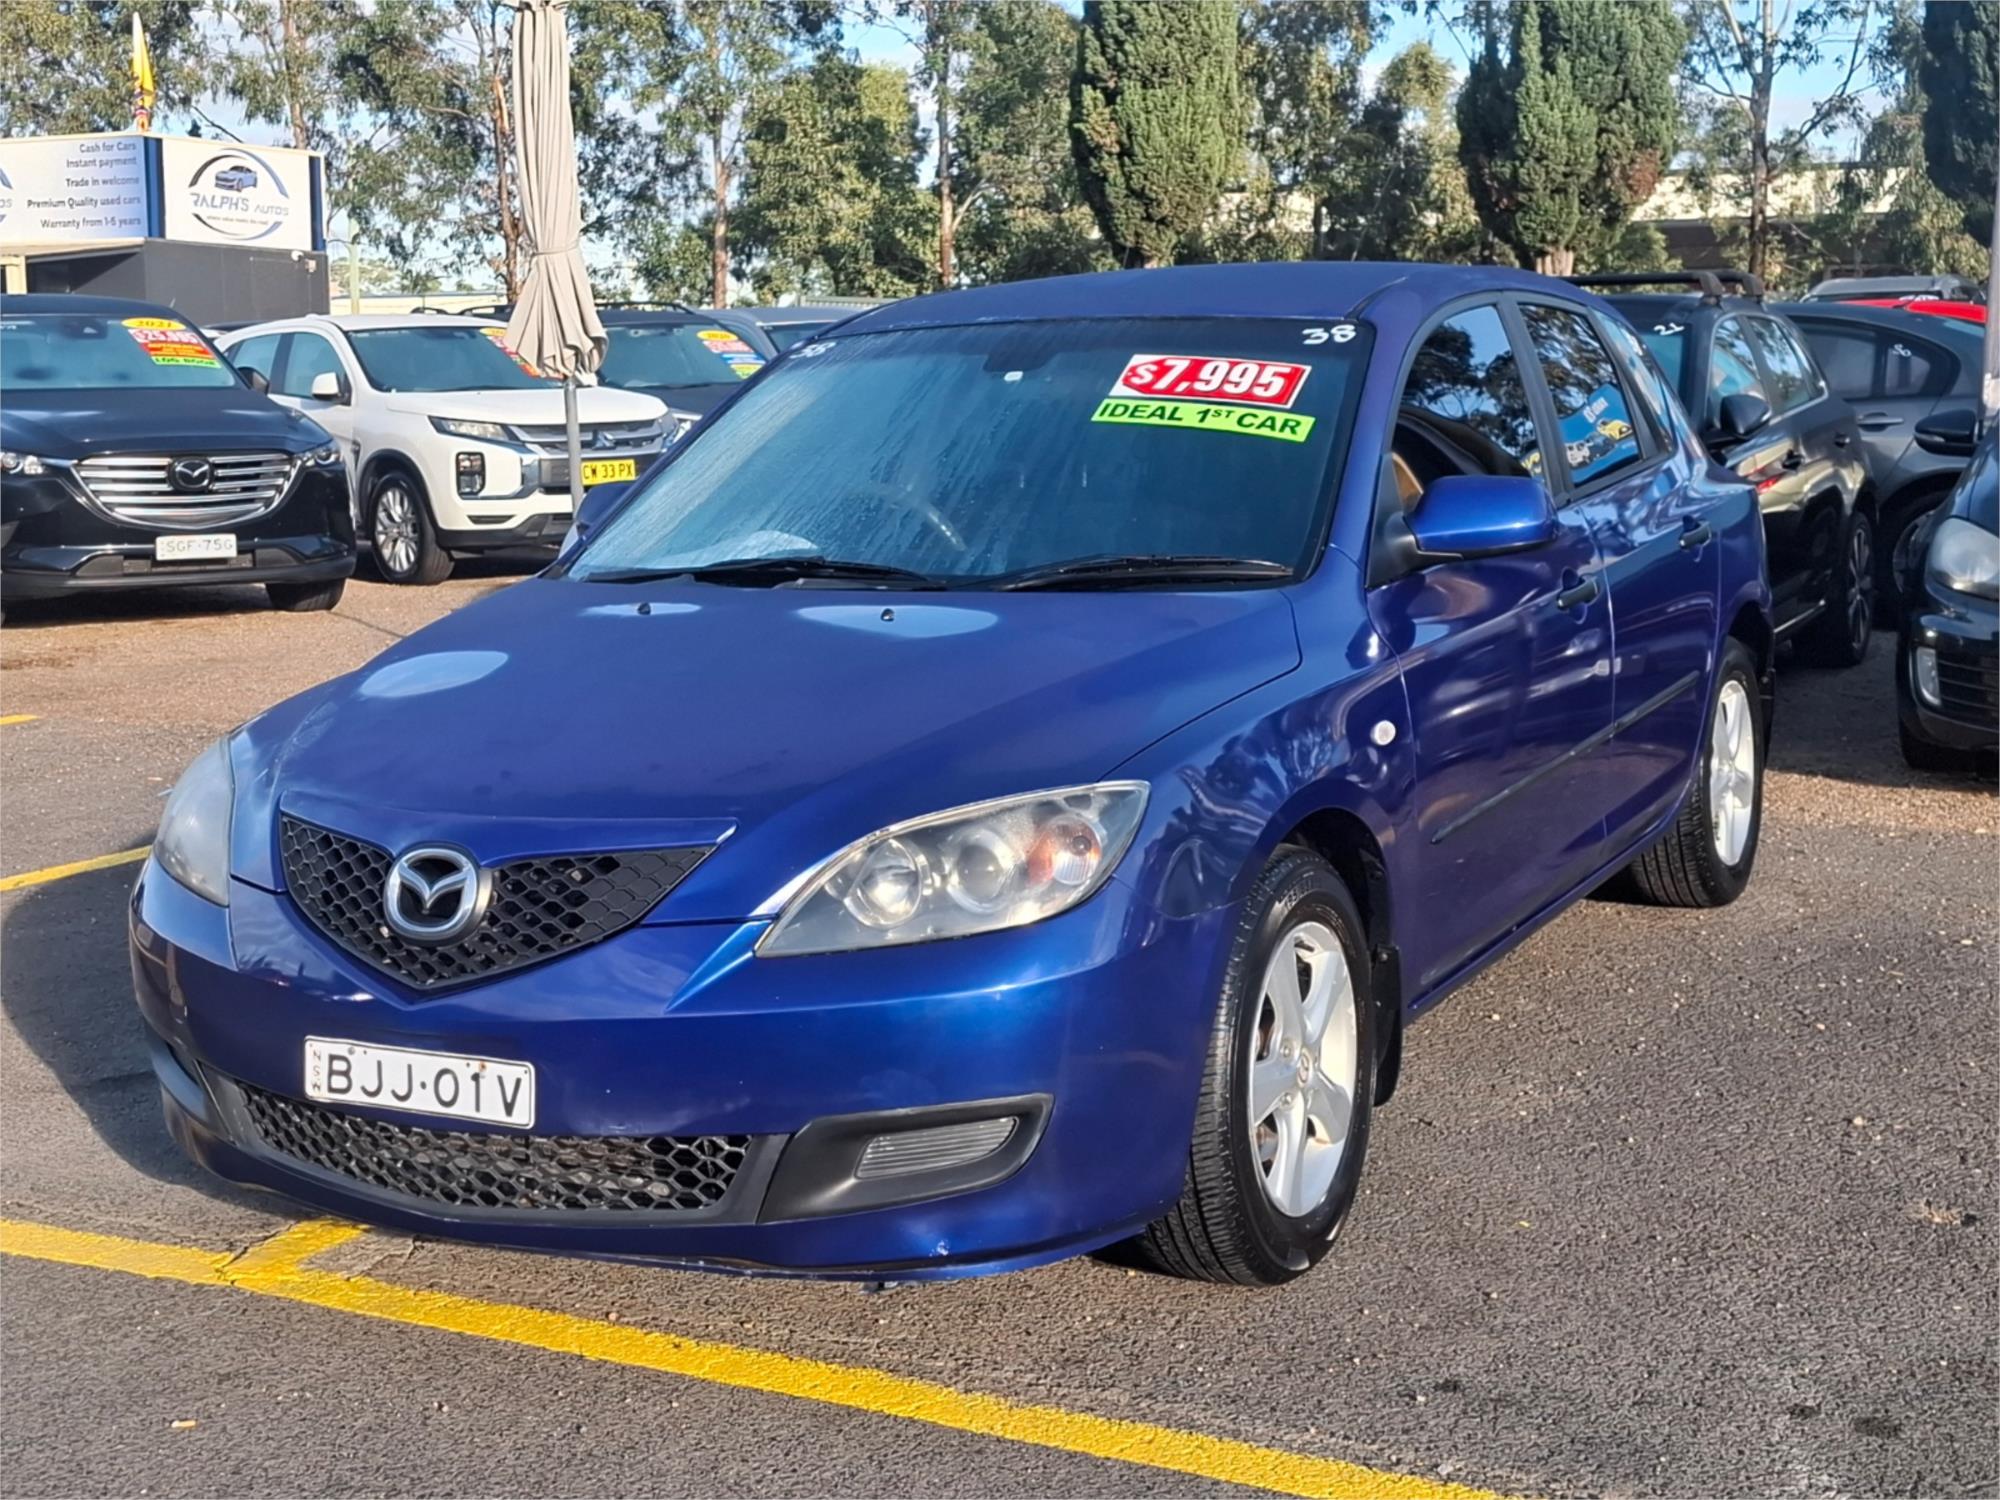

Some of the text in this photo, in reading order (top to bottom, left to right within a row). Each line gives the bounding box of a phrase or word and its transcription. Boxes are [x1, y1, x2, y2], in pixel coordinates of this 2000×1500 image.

[79, 141, 137, 153] Cash for Cars
[66, 157, 137, 168] Instant payment
[66, 176, 140, 187] Trade in welcome
[27, 195, 141, 208] Premium Quality used cars
[40, 219, 80, 229] Warranty
[82, 217, 102, 227] from
[119, 217, 141, 228] years
[1302, 324, 1356, 345] 38
[1129, 358, 1292, 398] $7,995
[1098, 402, 1185, 423] IDEAL
[1236, 412, 1302, 436] CAR
[602, 461, 616, 479] 33
[619, 461, 634, 478] PX
